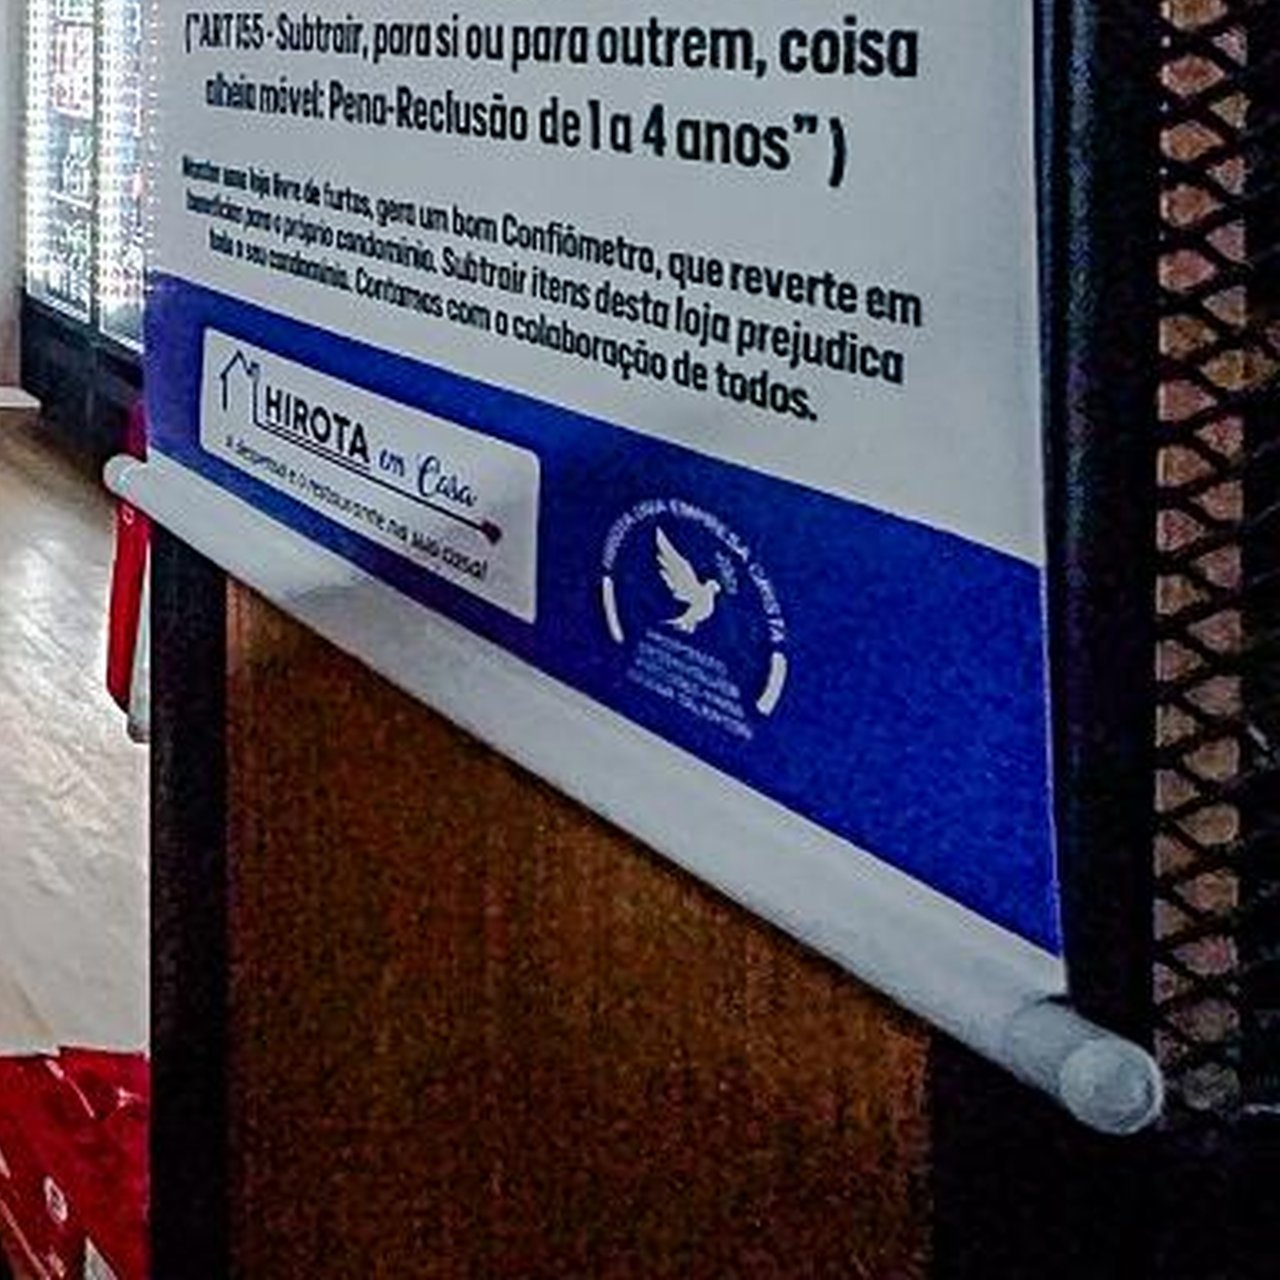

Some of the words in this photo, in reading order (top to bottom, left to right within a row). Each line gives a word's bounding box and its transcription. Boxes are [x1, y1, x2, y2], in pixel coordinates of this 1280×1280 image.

[275, 12, 369, 60] Subtrair,
[373, 20, 432, 64] para
[436, 13, 459, 58] si
[465, 22, 505, 60] ou
[512, 25, 588, 73] para
[597, 17, 767, 79] outrem,
[779, 14, 919, 78] coisa
[329, 80, 528, 140] Pena-Reclusão
[540, 96, 581, 148] de
[588, 99, 600, 151] 1
[610, 112, 633, 155] a
[642, 103, 667, 157] 4
[304, 177, 321, 207] de
[324, 181, 374, 220] furtos,
[377, 197, 415, 227] gera
[419, 205, 449, 232] um
[453, 203, 498, 244] bom
[669, 252, 724, 290] que
[730, 260, 858, 314] reverte
[866, 285, 922, 328] em
[442, 246, 527, 294] Subtrair
[531, 265, 591, 311] itens
[595, 281, 669, 330] desta
[675, 296, 731, 348] loja
[737, 319, 904, 386] prejudica
[355, 266, 443, 319] Contamos
[446, 297, 491, 332] com
[496, 310, 509, 337] a
[512, 313, 668, 382] colaboração
[673, 349, 708, 391] de
[716, 361, 818, 422] todos.
[265, 386, 370, 463] HIROTA
[417, 455, 478, 507] Casa
